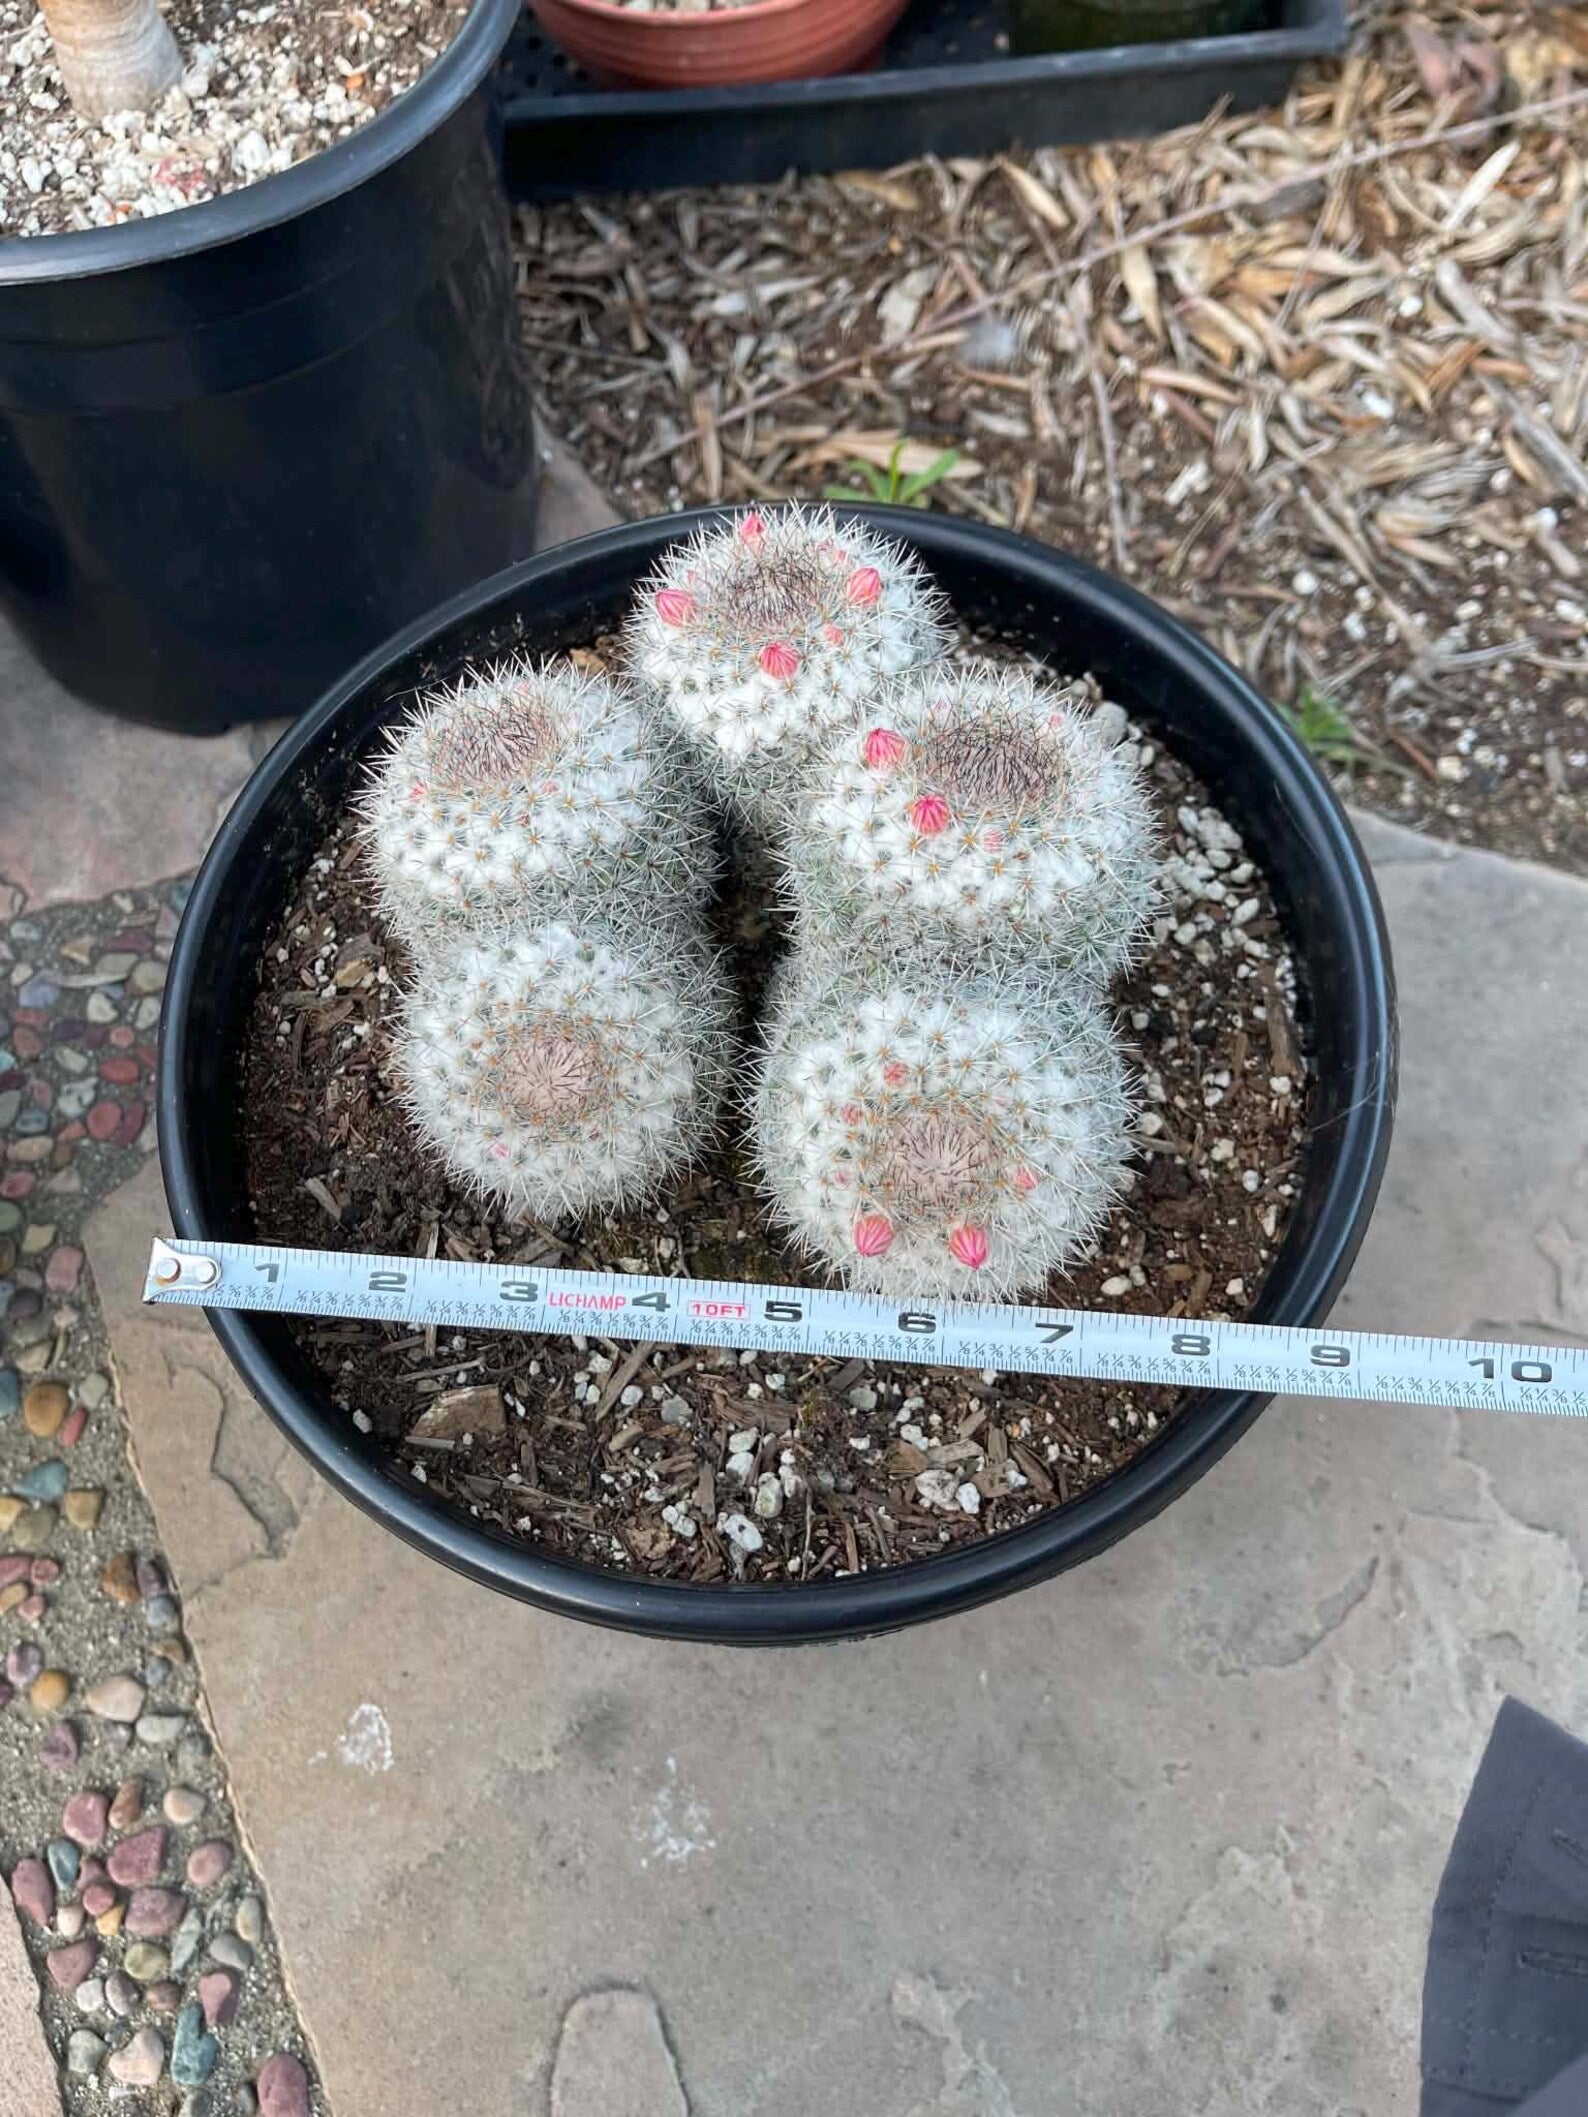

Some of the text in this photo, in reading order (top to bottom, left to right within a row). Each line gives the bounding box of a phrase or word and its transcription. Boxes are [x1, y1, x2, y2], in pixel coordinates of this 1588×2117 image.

[254, 1263, 1553, 1383] 1 2 3 LICHAMP 4 10FT 5 6 7 8 9 10
